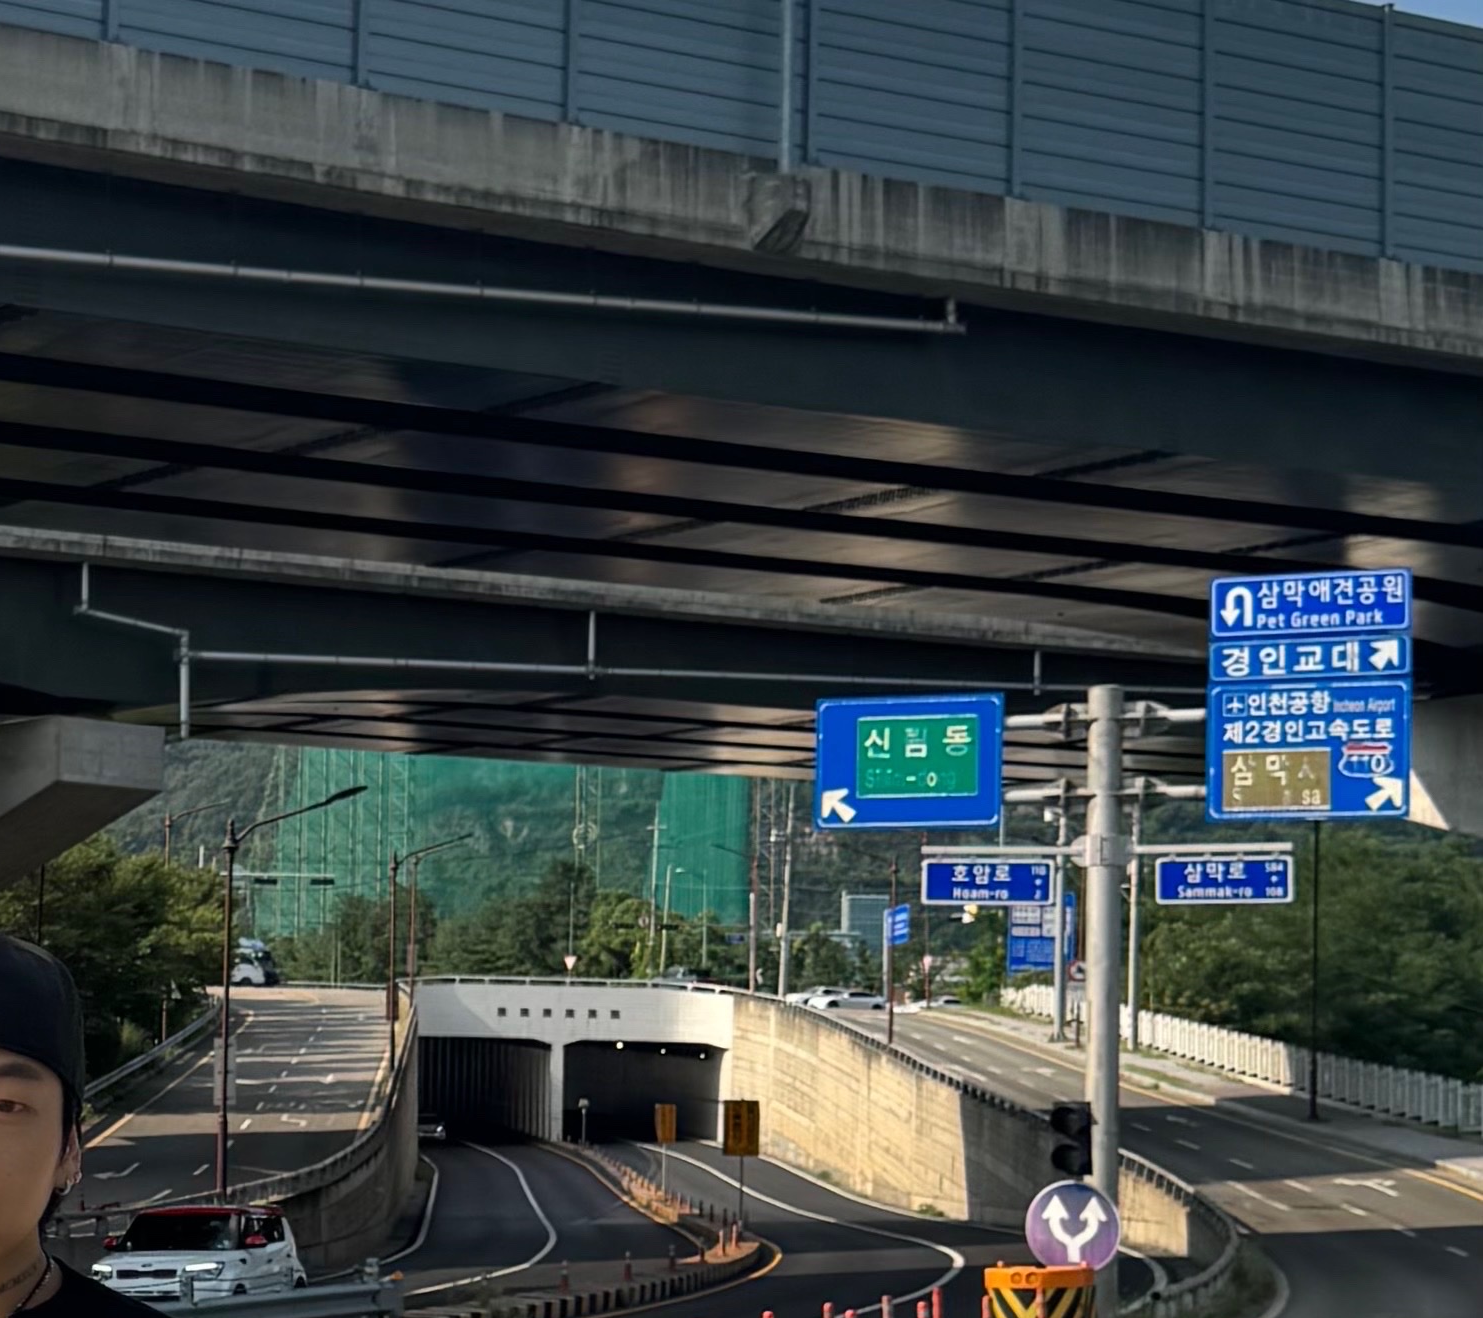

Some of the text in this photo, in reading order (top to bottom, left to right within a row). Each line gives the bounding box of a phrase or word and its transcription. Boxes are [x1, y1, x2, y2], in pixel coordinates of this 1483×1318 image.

[1257, 576, 1405, 609] 삼막애견공원
[1257, 609, 1384, 629] Pet Green Park
[1221, 640, 1360, 677] 경인교대
[1248, 691, 1331, 716] 인천공항
[863, 725, 972, 759] 신림동
[1222, 718, 1396, 744] 제2경인고속도로
[951, 865, 1012, 885] 호암로
[1184, 863, 1247, 884] 삼막로
[952, 887, 1009, 899] Hoam-ro
[1177, 885, 1253, 899] Sammak-ro
